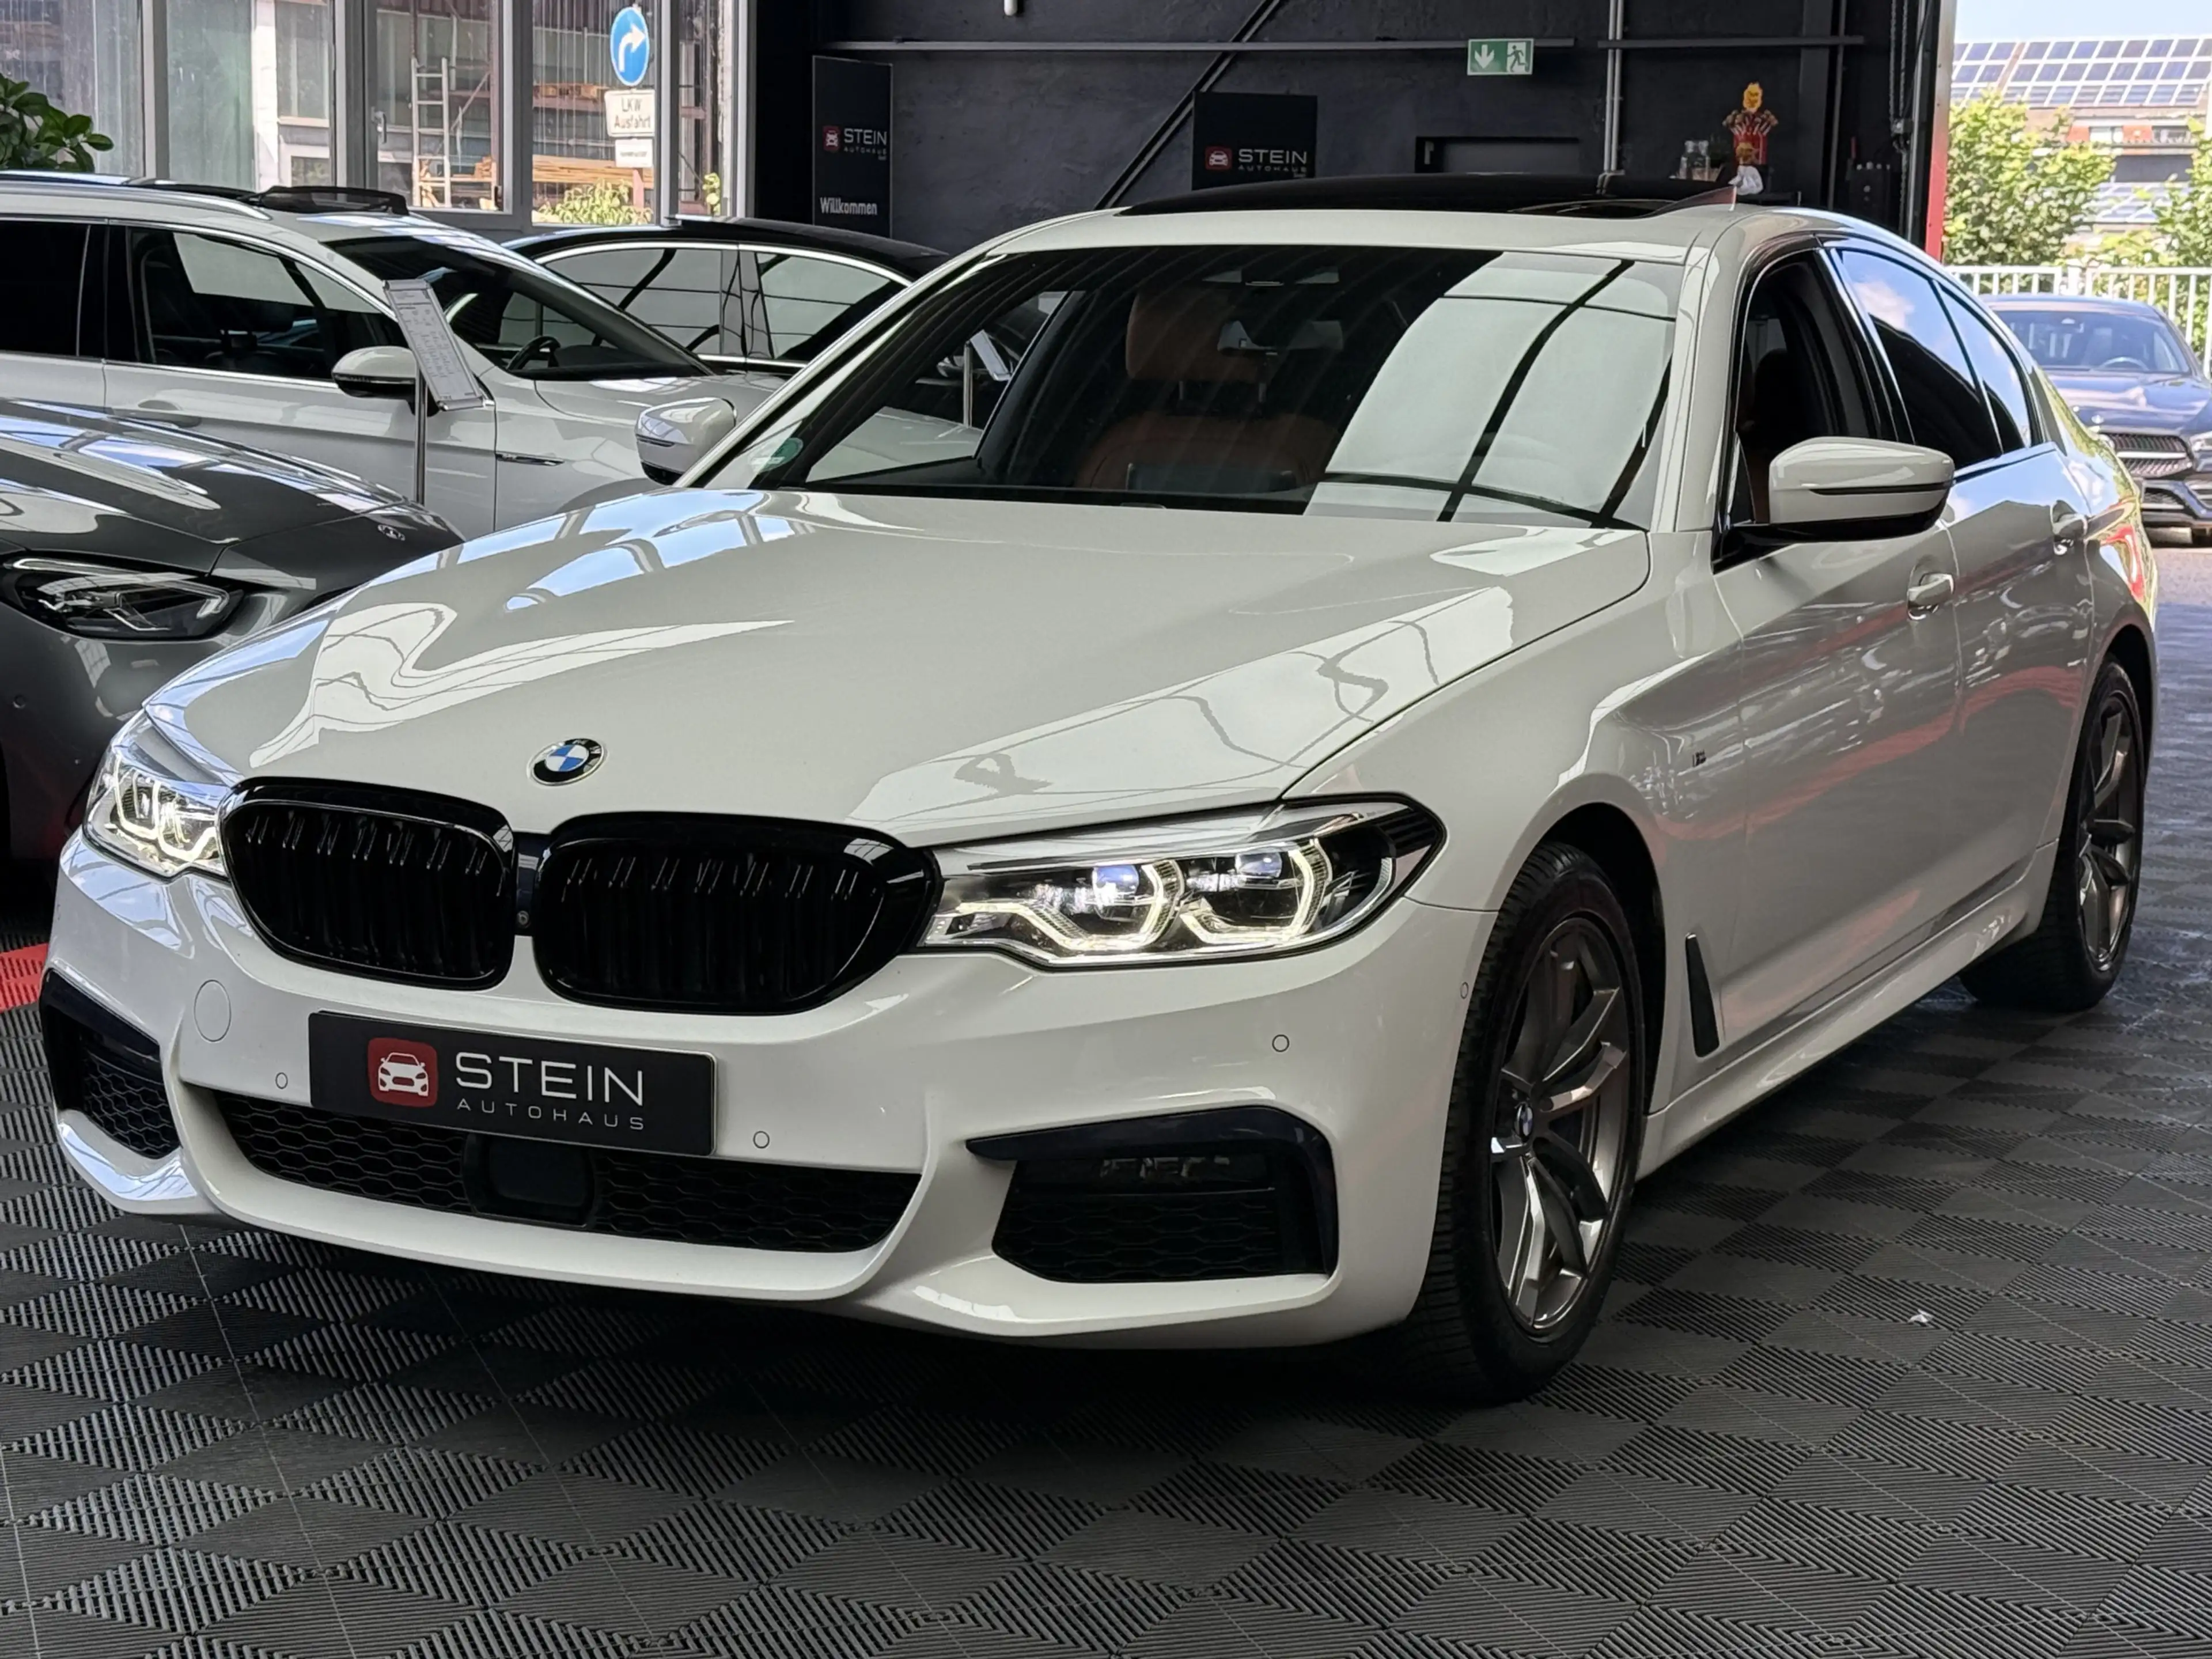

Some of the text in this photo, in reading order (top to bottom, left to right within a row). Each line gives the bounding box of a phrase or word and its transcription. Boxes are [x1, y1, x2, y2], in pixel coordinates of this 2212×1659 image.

[621, 97, 643, 112] LKW
[614, 115, 651, 128] Ausfahrt
[844, 128, 887, 145] STEIN
[844, 146, 887, 154] AUTOHAUS
[1238, 148, 1307, 165] STEIN
[820, 197, 878, 215] Willkommen
[456, 1051, 644, 1107] STEIN
[457, 1098, 644, 1131] AUTOHAUS
